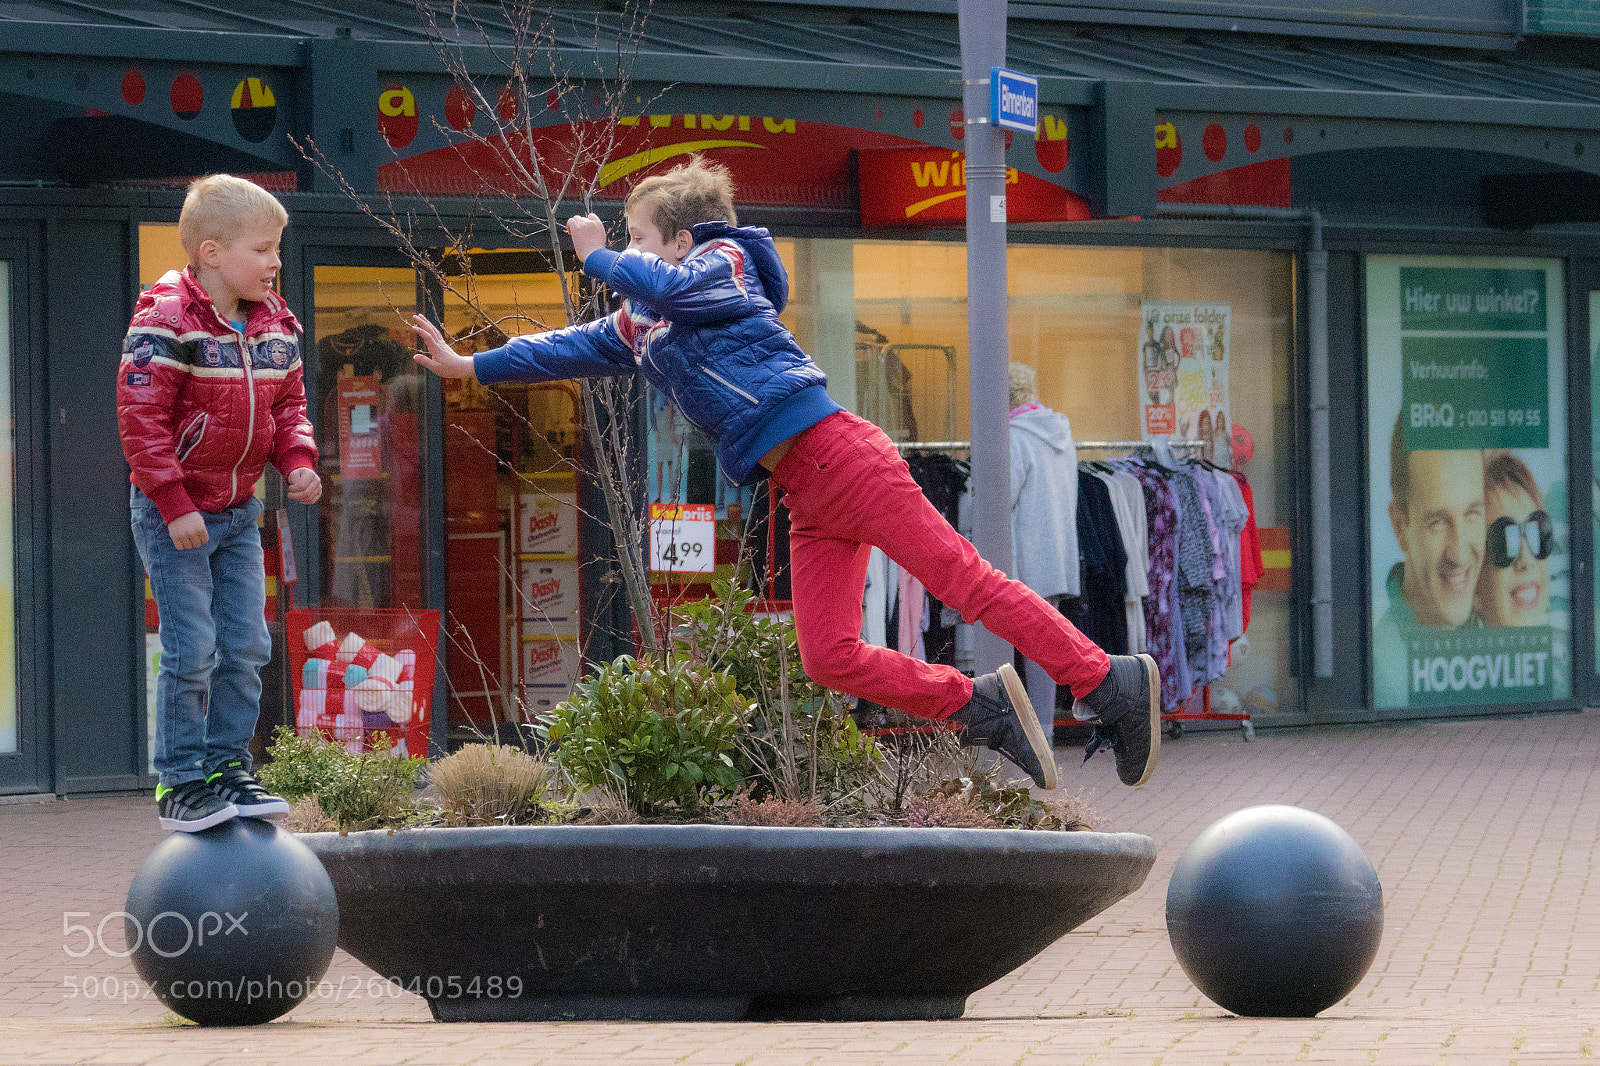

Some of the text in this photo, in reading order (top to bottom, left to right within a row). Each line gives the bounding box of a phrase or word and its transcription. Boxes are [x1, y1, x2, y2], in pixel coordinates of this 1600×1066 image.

[1002, 84, 1035, 118] Binnenban
[1405, 286, 1539, 314] Hier uw winkel?
[1163, 313, 1191, 324] onze
[1194, 306, 1227, 324] folder
[1467, 410, 1488, 427] 010
[1507, 410, 1524, 427] 99
[1525, 409, 1541, 427] 55
[530, 511, 559, 533] Dasty
[532, 577, 561, 599] Dasty
[1413, 652, 1549, 692] HOOGVLIET
